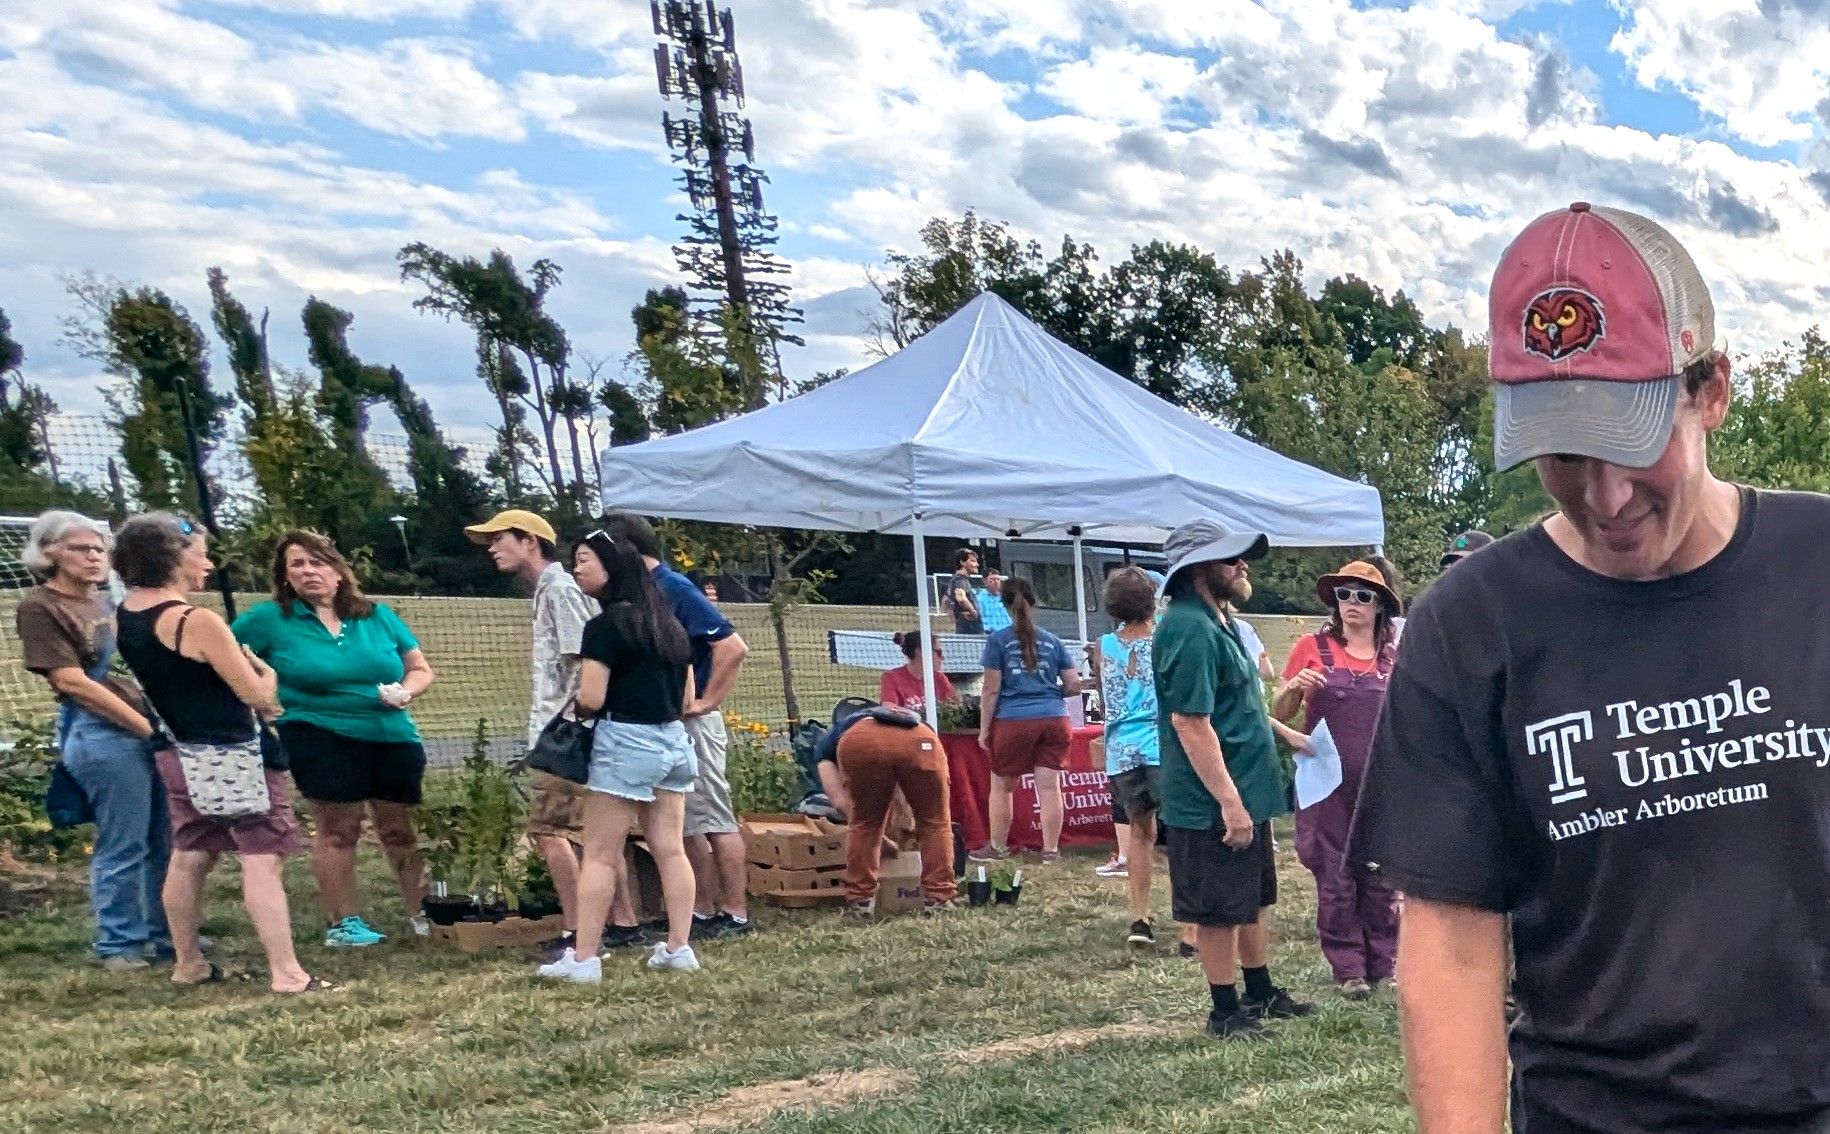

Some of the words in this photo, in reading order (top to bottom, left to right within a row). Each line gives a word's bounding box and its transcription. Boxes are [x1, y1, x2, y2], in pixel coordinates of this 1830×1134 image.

[1605, 678, 1772, 740] Temple
[1060, 769, 1110, 789] Temp
[1061, 789, 1112, 810] Unive
[1547, 807, 1629, 841] Ambler
[1635, 782, 1769, 821] Arboretum
